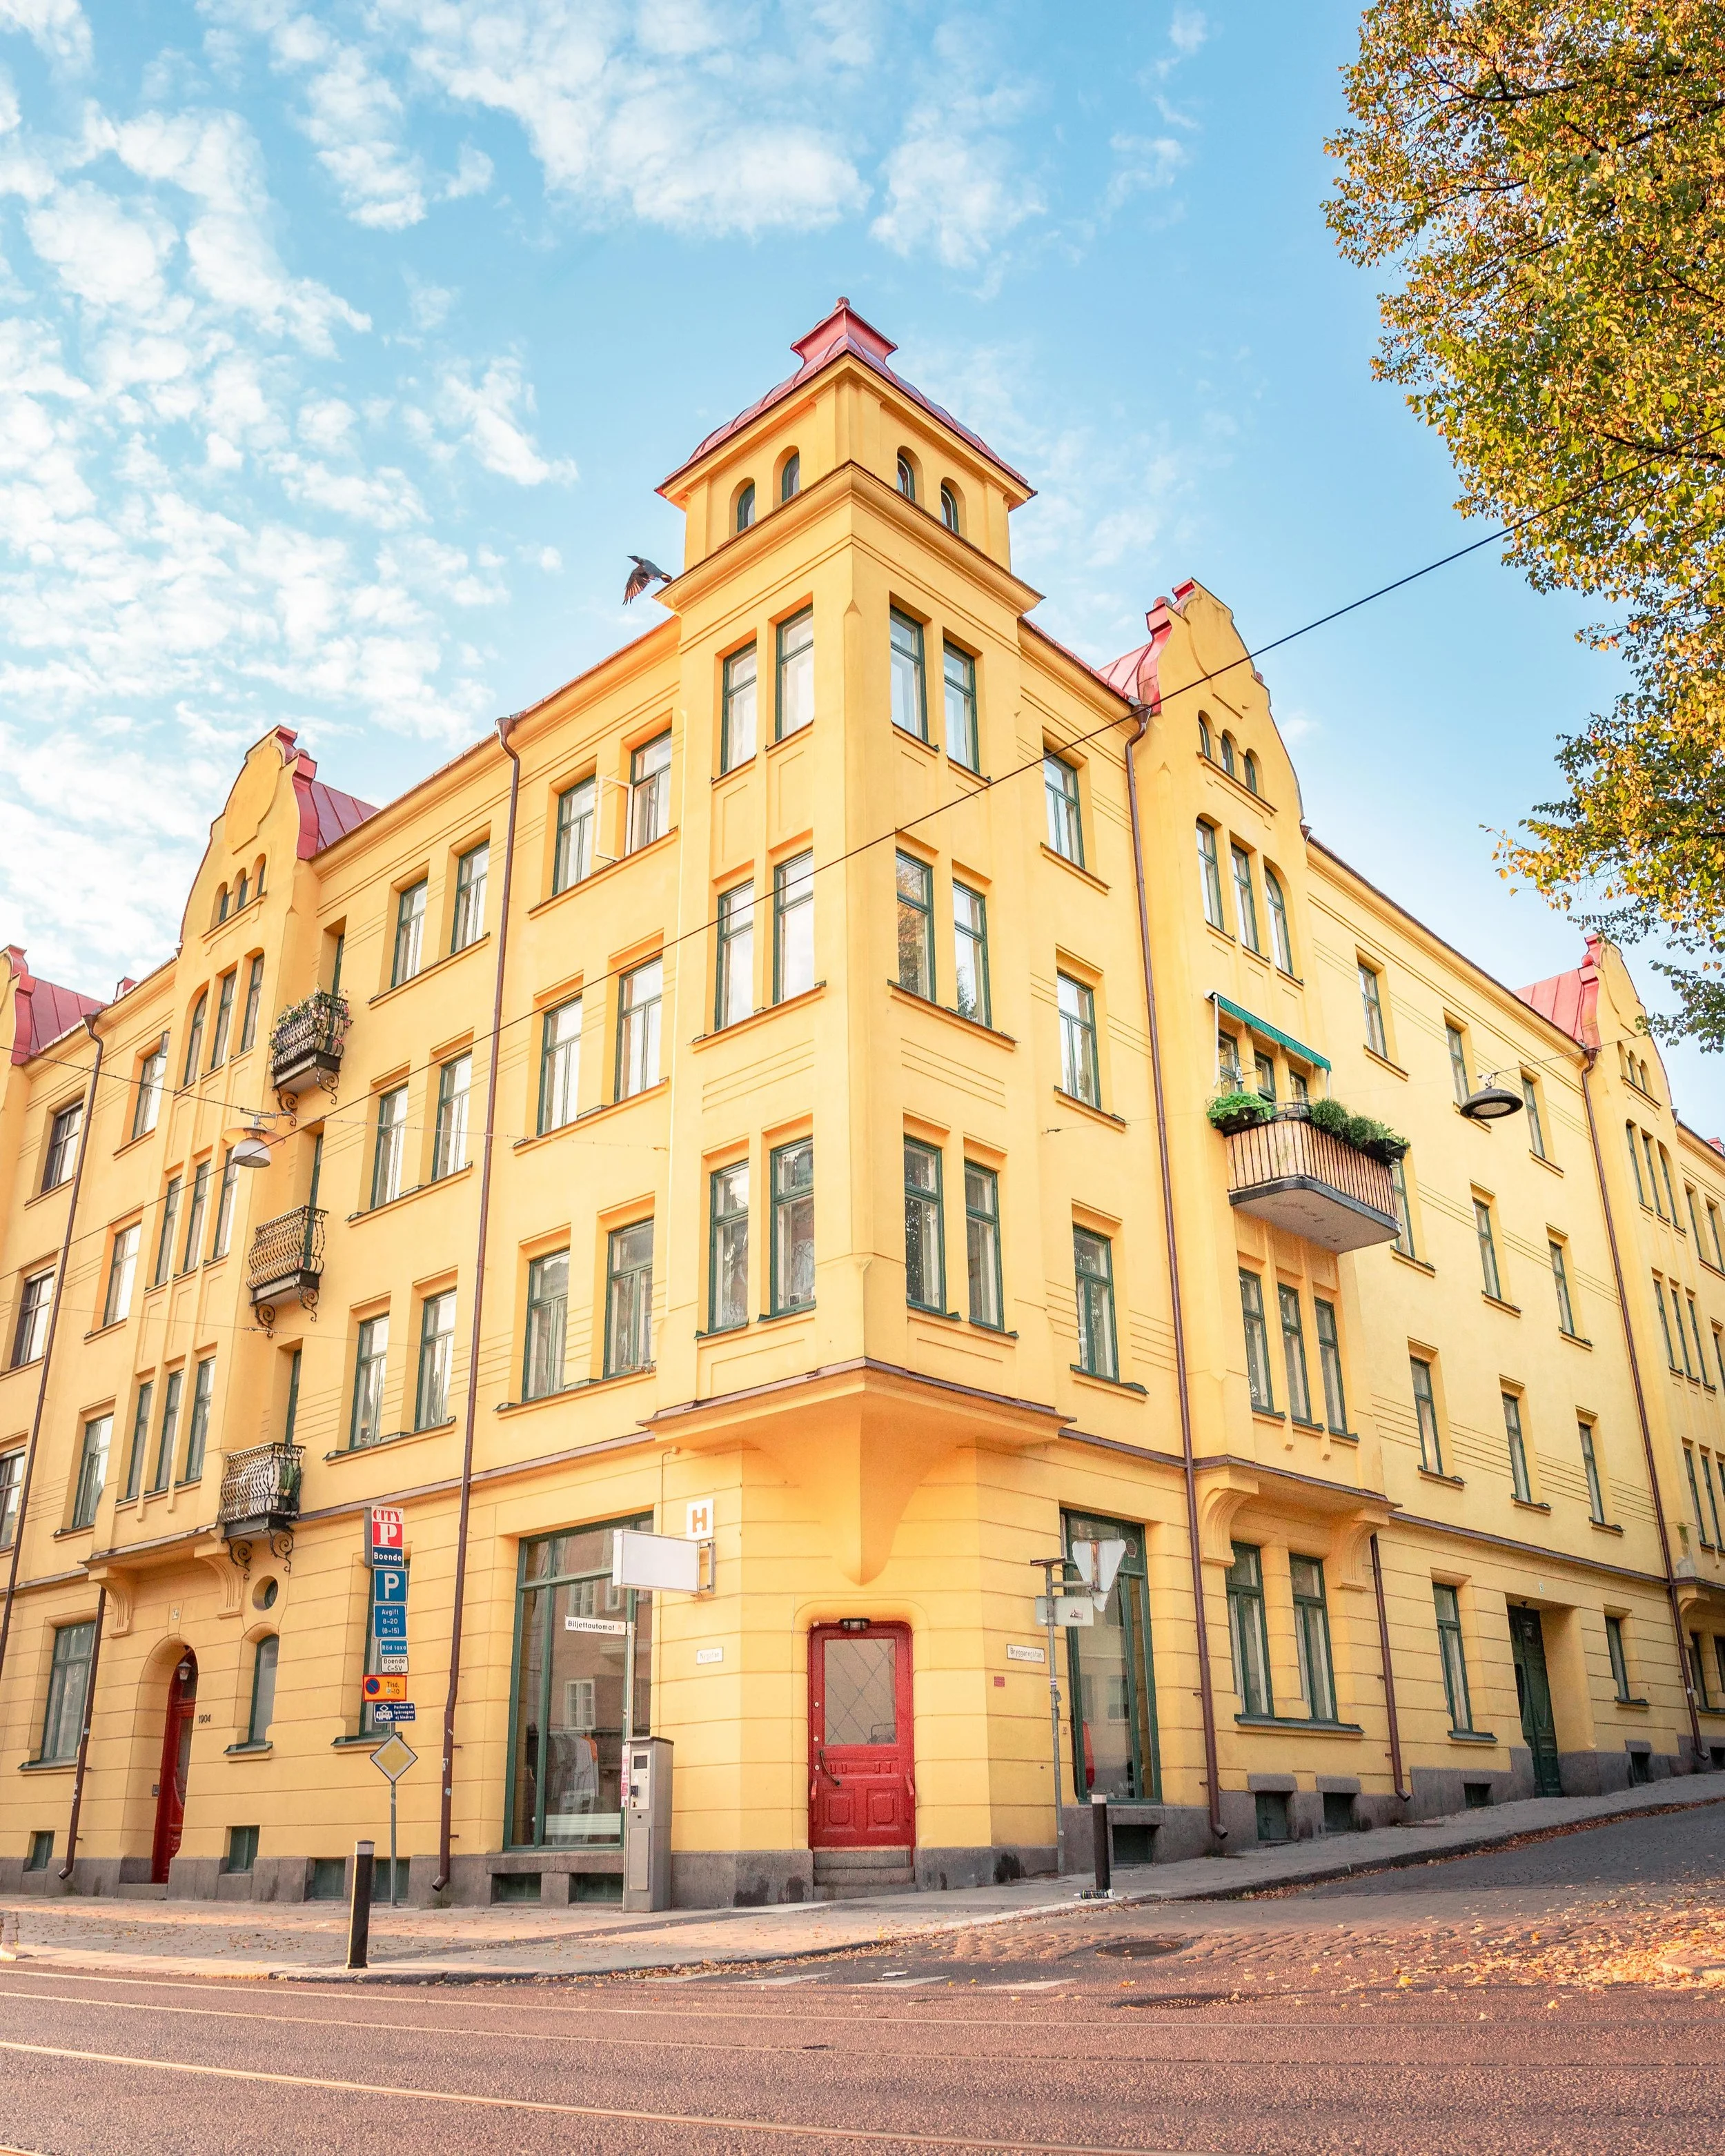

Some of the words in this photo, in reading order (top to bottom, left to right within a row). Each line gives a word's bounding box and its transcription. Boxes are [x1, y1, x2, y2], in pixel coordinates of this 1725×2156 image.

[373, 1510, 402, 1522] CITY
[378, 1523, 397, 1545] P
[373, 1552, 402, 1561] Boende
[384, 1572, 400, 1599] P
[382, 1608, 399, 1616] Avgift
[568, 1621, 615, 1631] Biljettautomat
[198, 1714, 211, 1723] 1904
